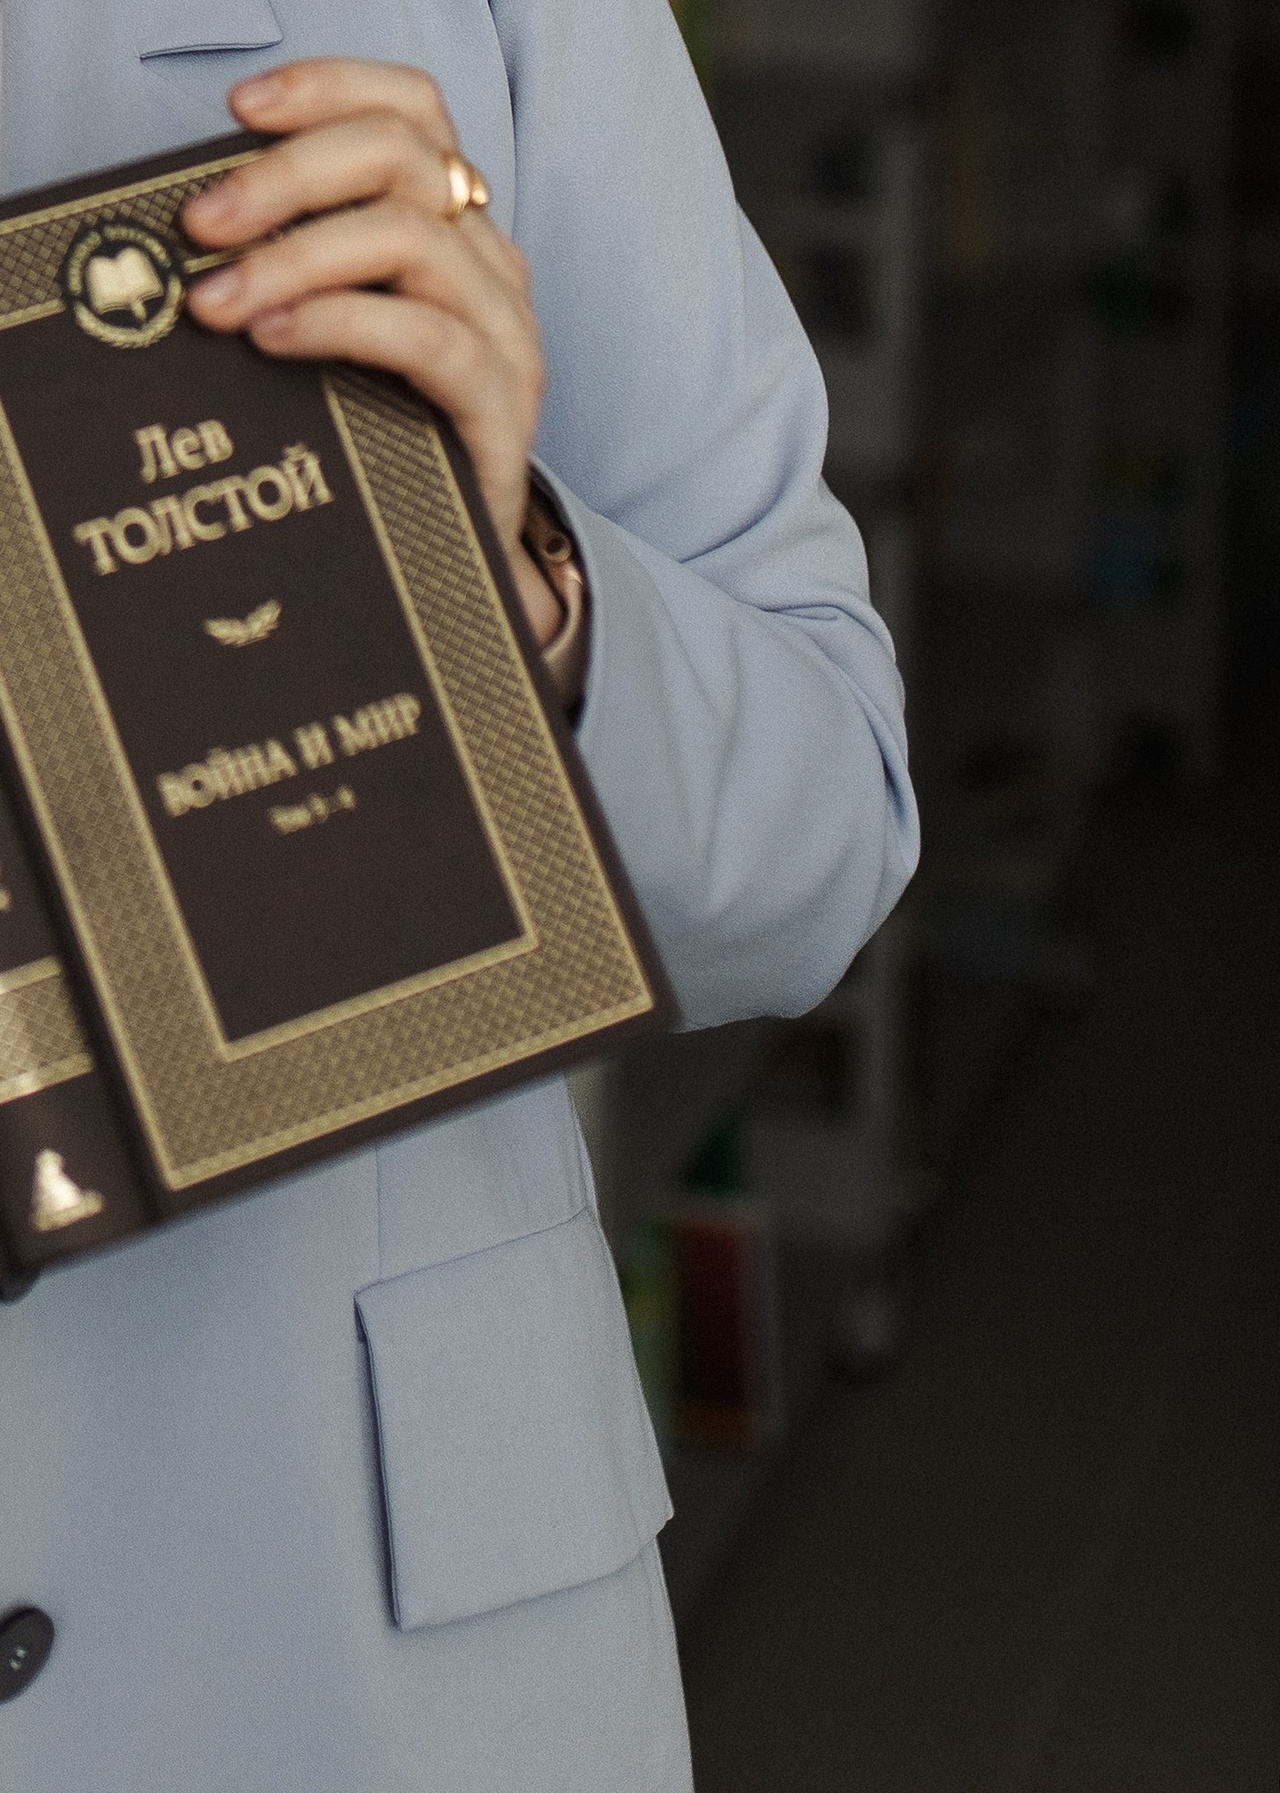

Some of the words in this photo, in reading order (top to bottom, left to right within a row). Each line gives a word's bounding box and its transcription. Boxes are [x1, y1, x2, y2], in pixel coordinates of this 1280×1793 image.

[72, 442, 336, 576] ТОЛСТОЙ
[135, 418, 235, 485] Лев
[155, 746, 299, 820] ВОЙНА
[292, 720, 336, 770] И
[331, 692, 422, 757] МИР
